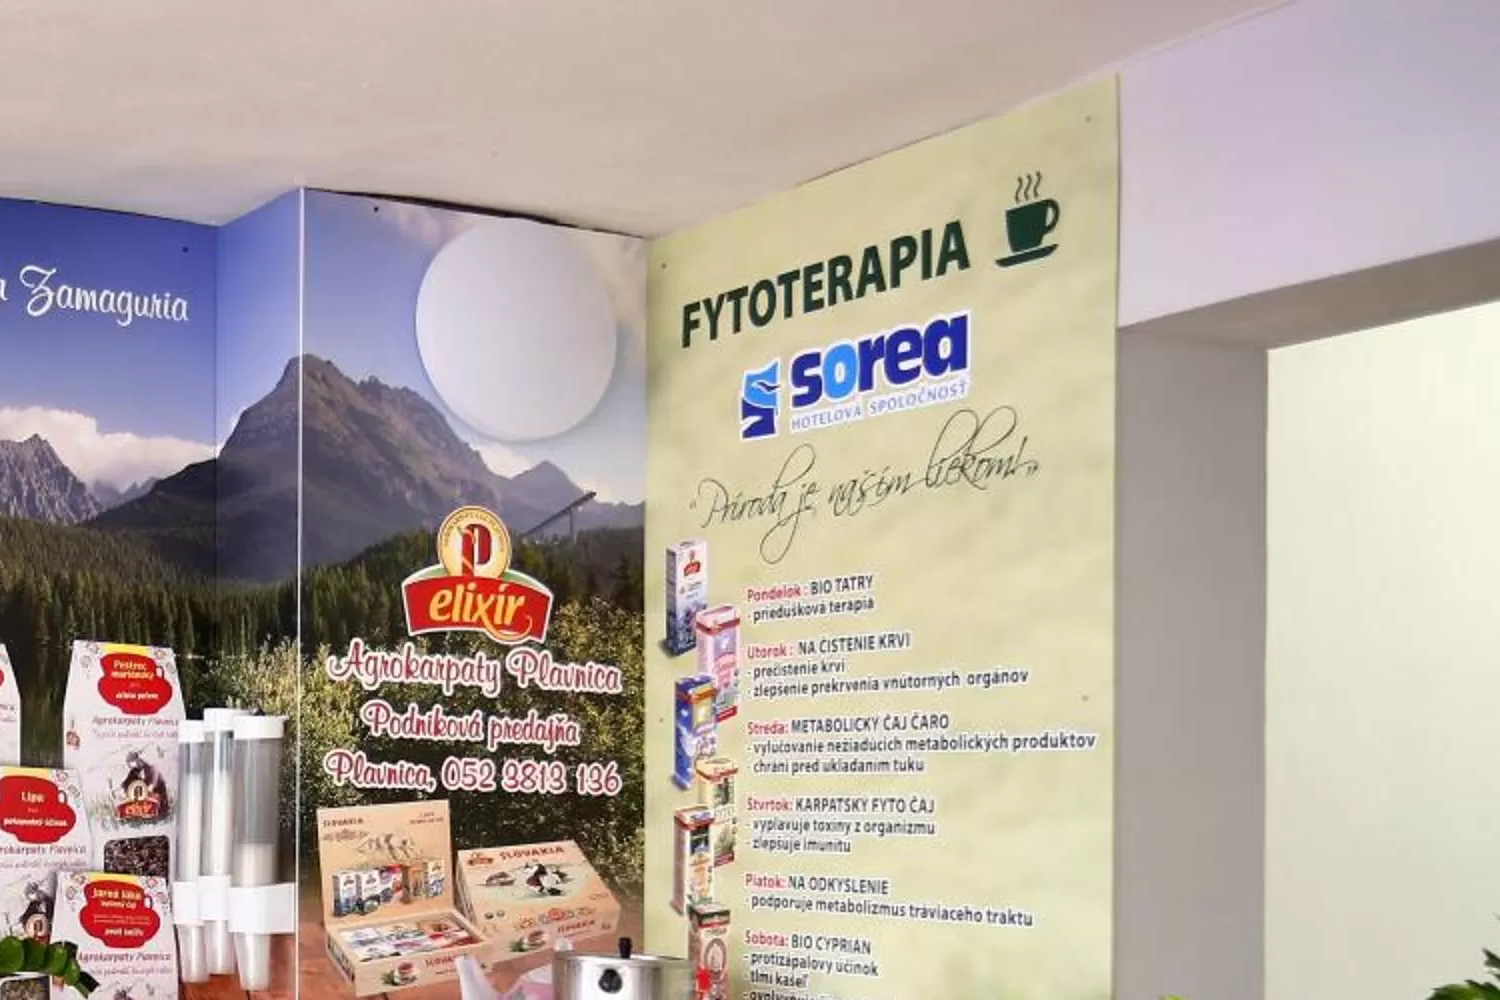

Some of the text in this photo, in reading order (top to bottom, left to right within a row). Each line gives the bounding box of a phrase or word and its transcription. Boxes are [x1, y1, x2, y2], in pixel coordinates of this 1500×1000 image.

[19, 264, 189, 326] Zamaguria
[681, 220, 971, 348] FYTOTERAPIA
[790, 314, 969, 408] sorea
[790, 378, 968, 430] HOTELOVÁ SPOLOČNOSŤ
[810, 579, 832, 596] BIO
[835, 575, 874, 591] TATRY
[429, 583, 533, 640] elixír
[798, 640, 817, 655] NA
[878, 632, 911, 649] KRVI
[328, 640, 621, 697] Agrokarpaty Plavnica
[821, 658, 846, 674] krvi
[812, 677, 880, 697] prekrvenia
[362, 701, 579, 752] Podniková predajňa
[883, 712, 907, 731] ČAJ
[911, 712, 949, 731] ČARO
[1013, 731, 1096, 752] produktov
[325, 751, 436, 792] Plavnica,
[791, 758, 819, 776] pred
[893, 756, 925, 773] tuku
[871, 797, 906, 813] FYTO
[909, 796, 935, 814] ČAJ
[864, 820, 935, 837] organizmu
[788, 876, 806, 891] NA
[809, 877, 889, 895] ODKYSLENIE
[816, 897, 906, 917] metabolizmus
[986, 908, 1033, 927] traktu
[791, 933, 813, 950] BIO
